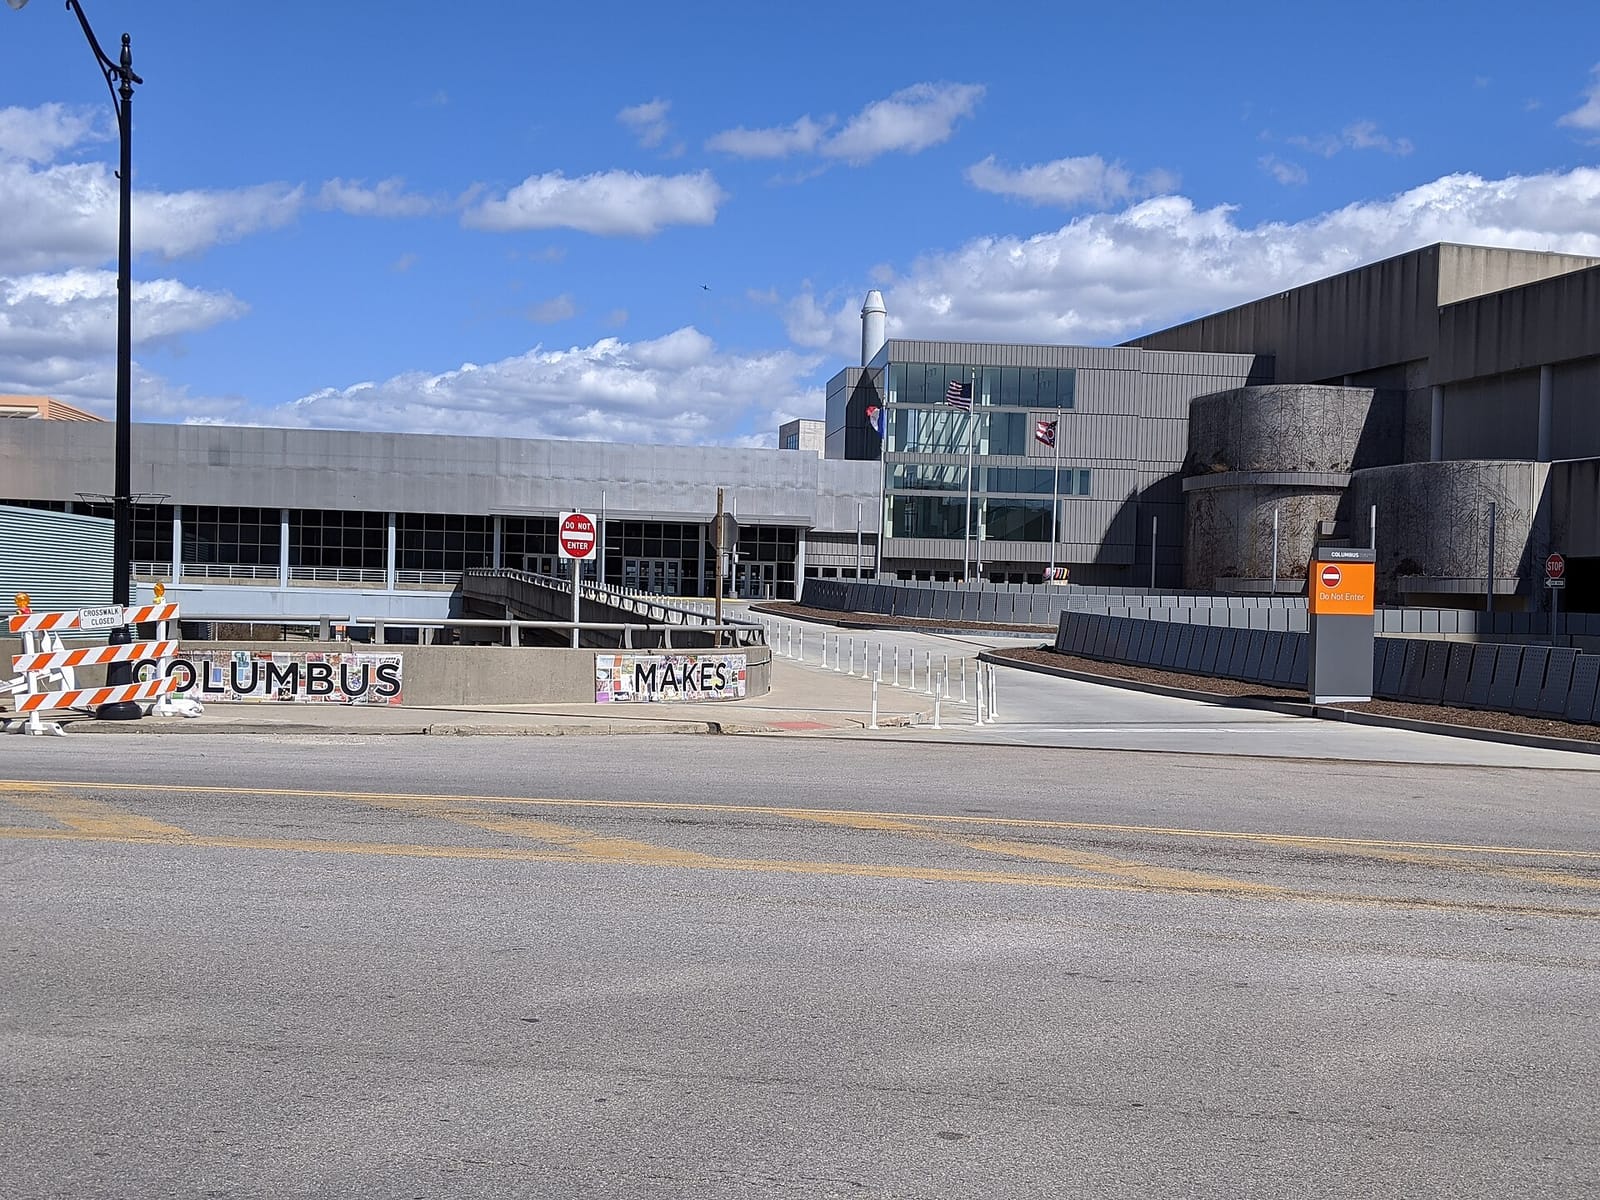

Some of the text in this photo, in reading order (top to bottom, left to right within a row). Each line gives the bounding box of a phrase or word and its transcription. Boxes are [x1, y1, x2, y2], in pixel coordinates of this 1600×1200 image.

[565, 521, 591, 531] DO NOT
[567, 541, 588, 550] ENTER
[1547, 561, 1563, 571] STOP
[1319, 592, 1365, 601] Do Not Enter
[83, 608, 119, 617] CROSSWALK
[91, 617, 115, 626] CLOSED
[132, 658, 402, 697] COLUMBUS
[635, 662, 726, 693] MAKES
